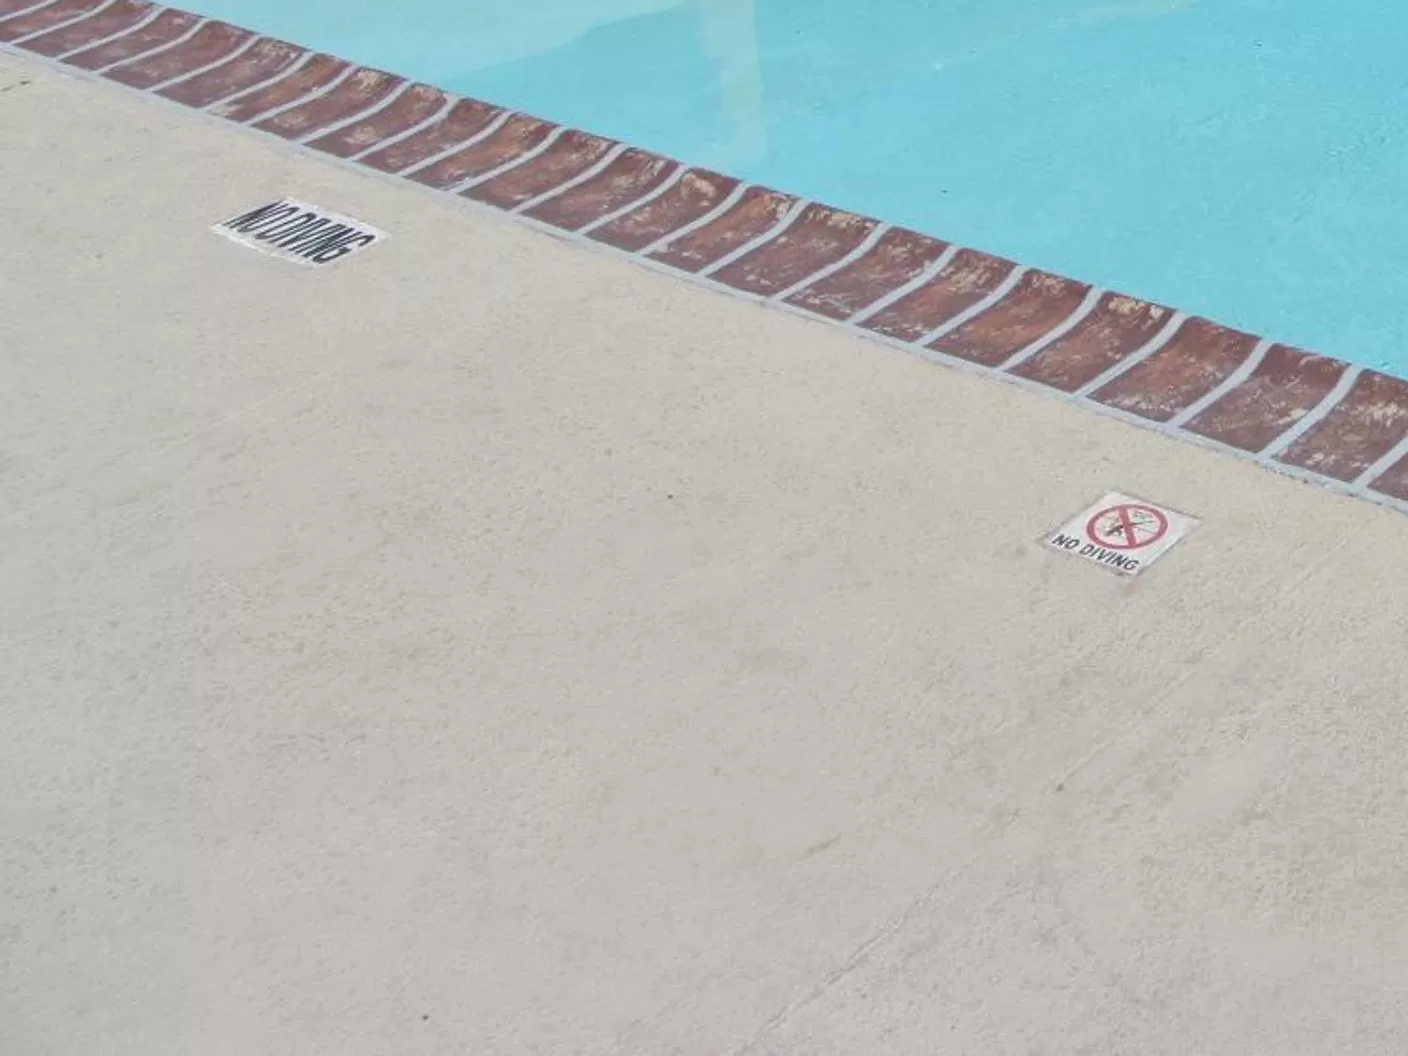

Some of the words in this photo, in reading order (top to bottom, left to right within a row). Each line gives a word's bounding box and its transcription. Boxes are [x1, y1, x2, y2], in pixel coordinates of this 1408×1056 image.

[222, 200, 300, 233] NO
[255, 212, 376, 264] DIVING
[1051, 534, 1081, 550] NO
[1079, 544, 1140, 571] DIVING
